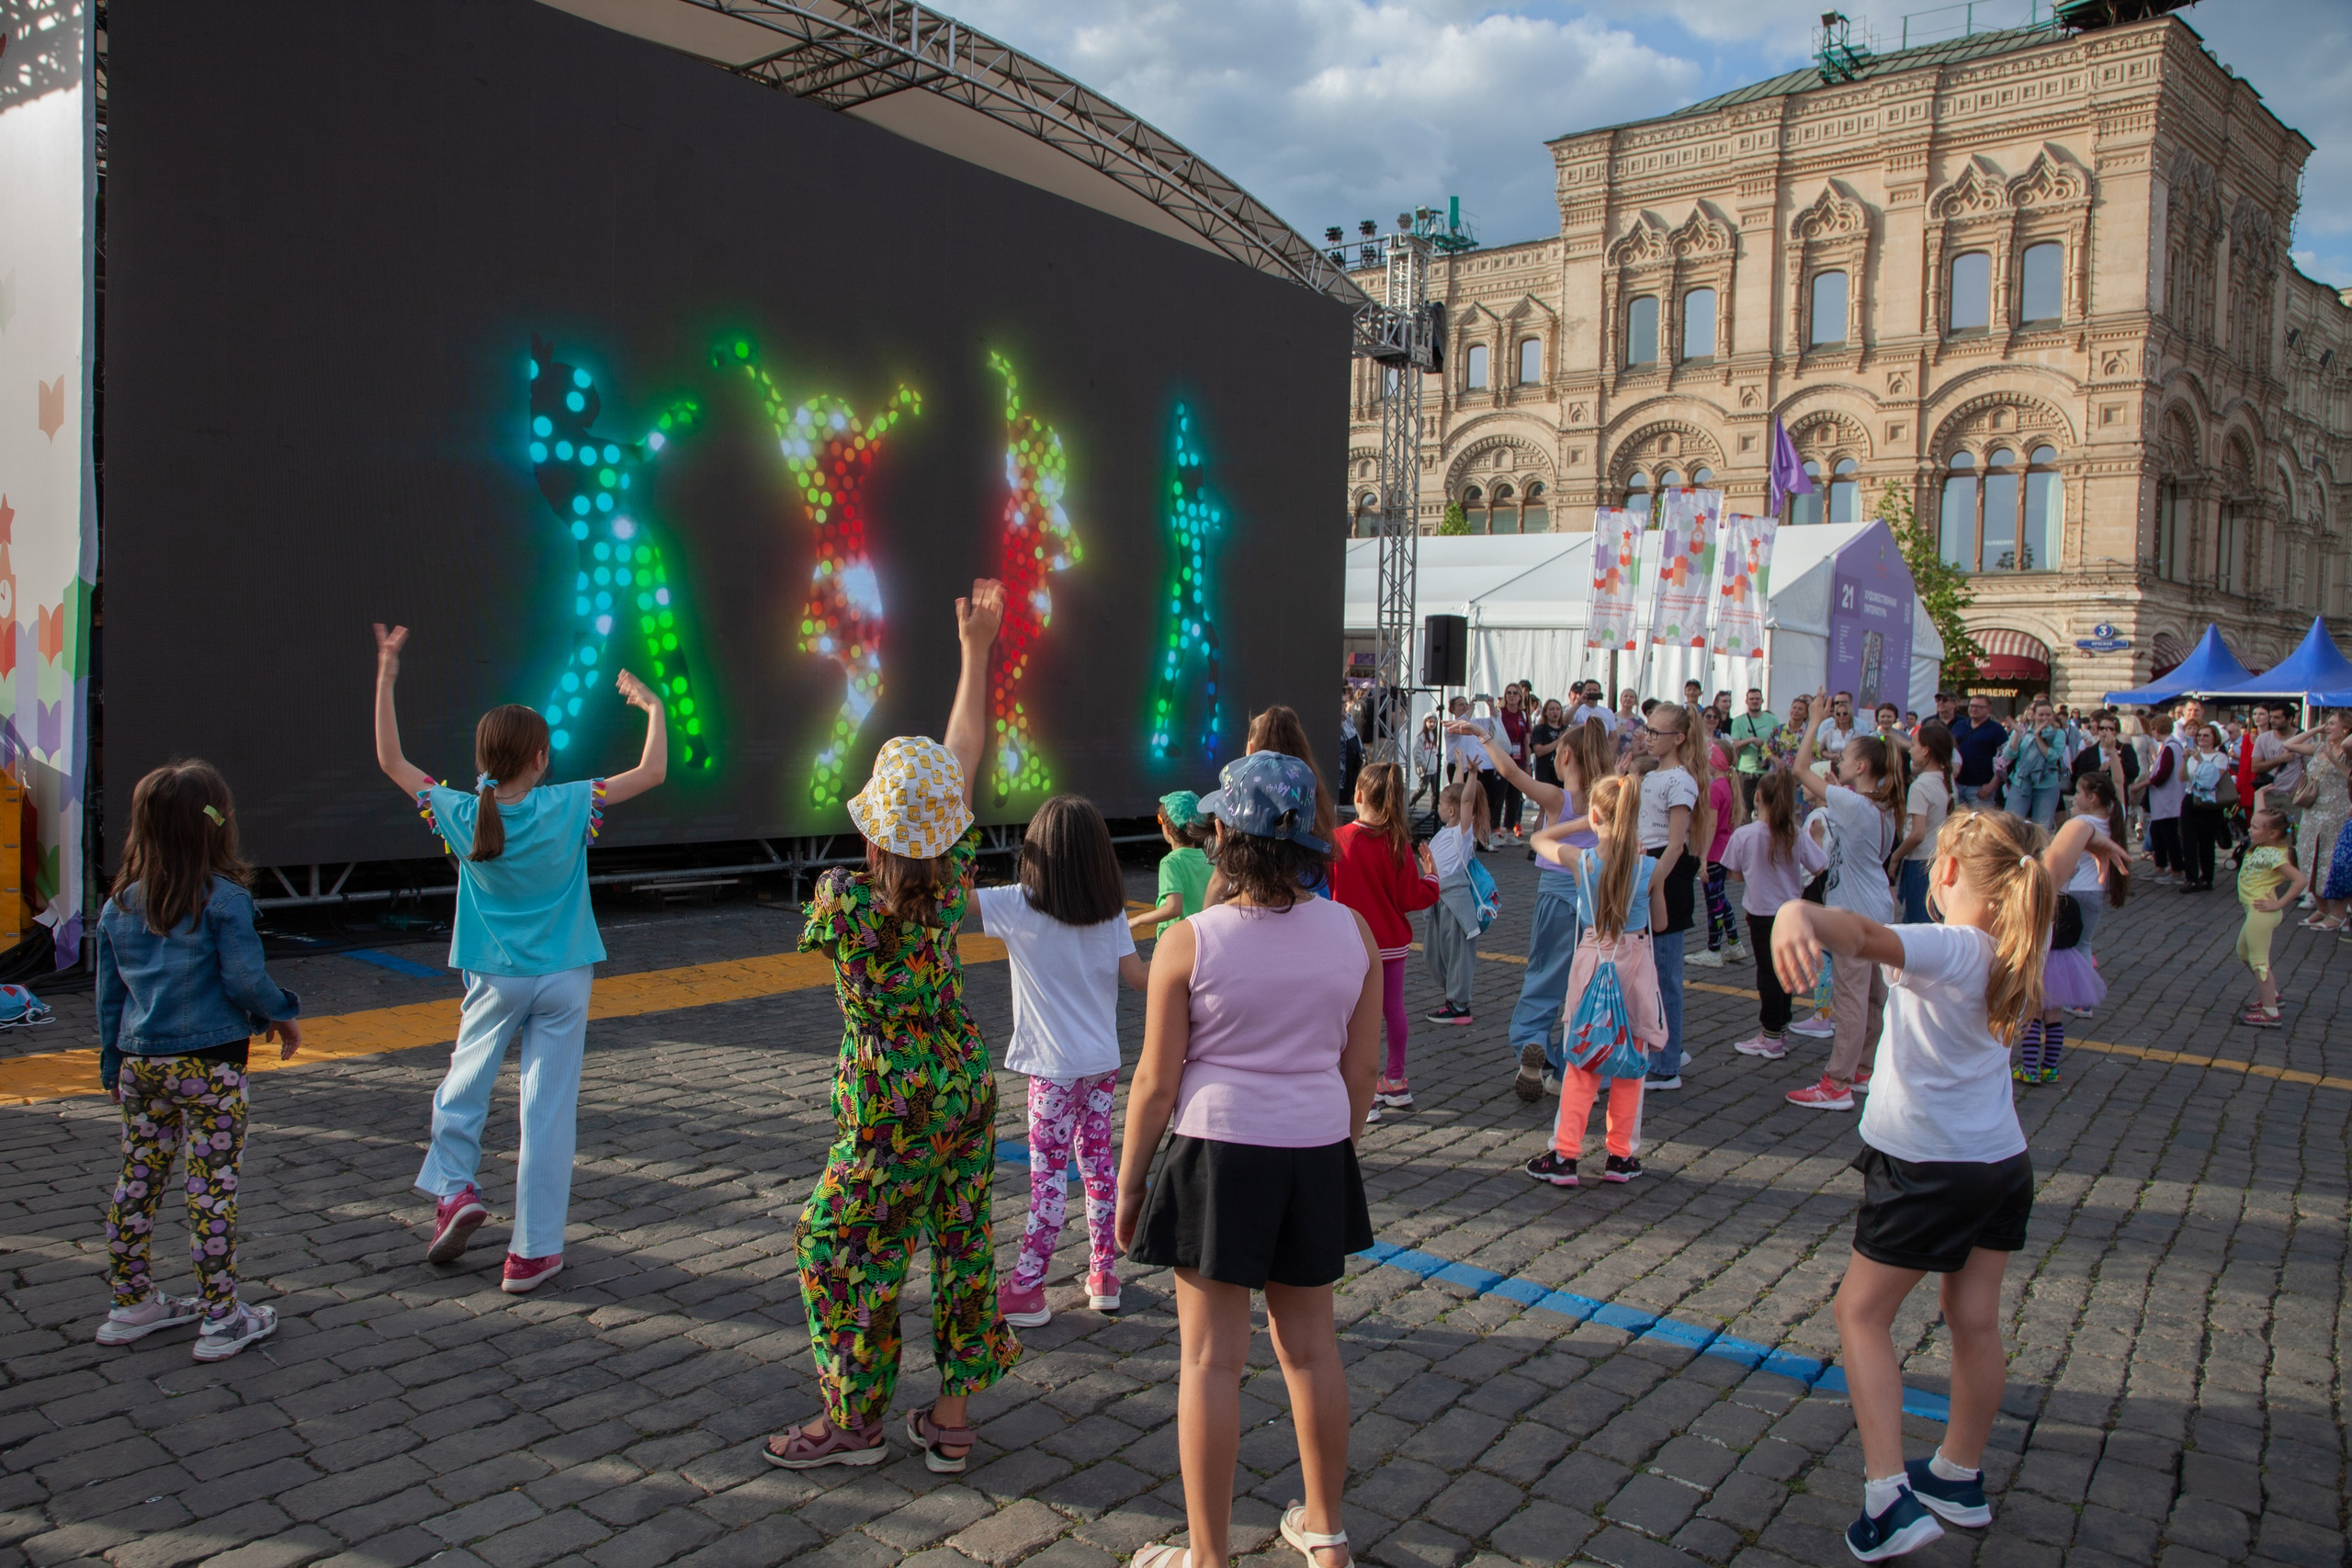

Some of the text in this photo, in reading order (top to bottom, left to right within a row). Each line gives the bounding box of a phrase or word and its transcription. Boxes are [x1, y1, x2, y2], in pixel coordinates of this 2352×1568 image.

[1841, 583, 1854, 610] 21
[2098, 626, 2108, 636] 3
[1967, 688, 2018, 697] BURBERRY
